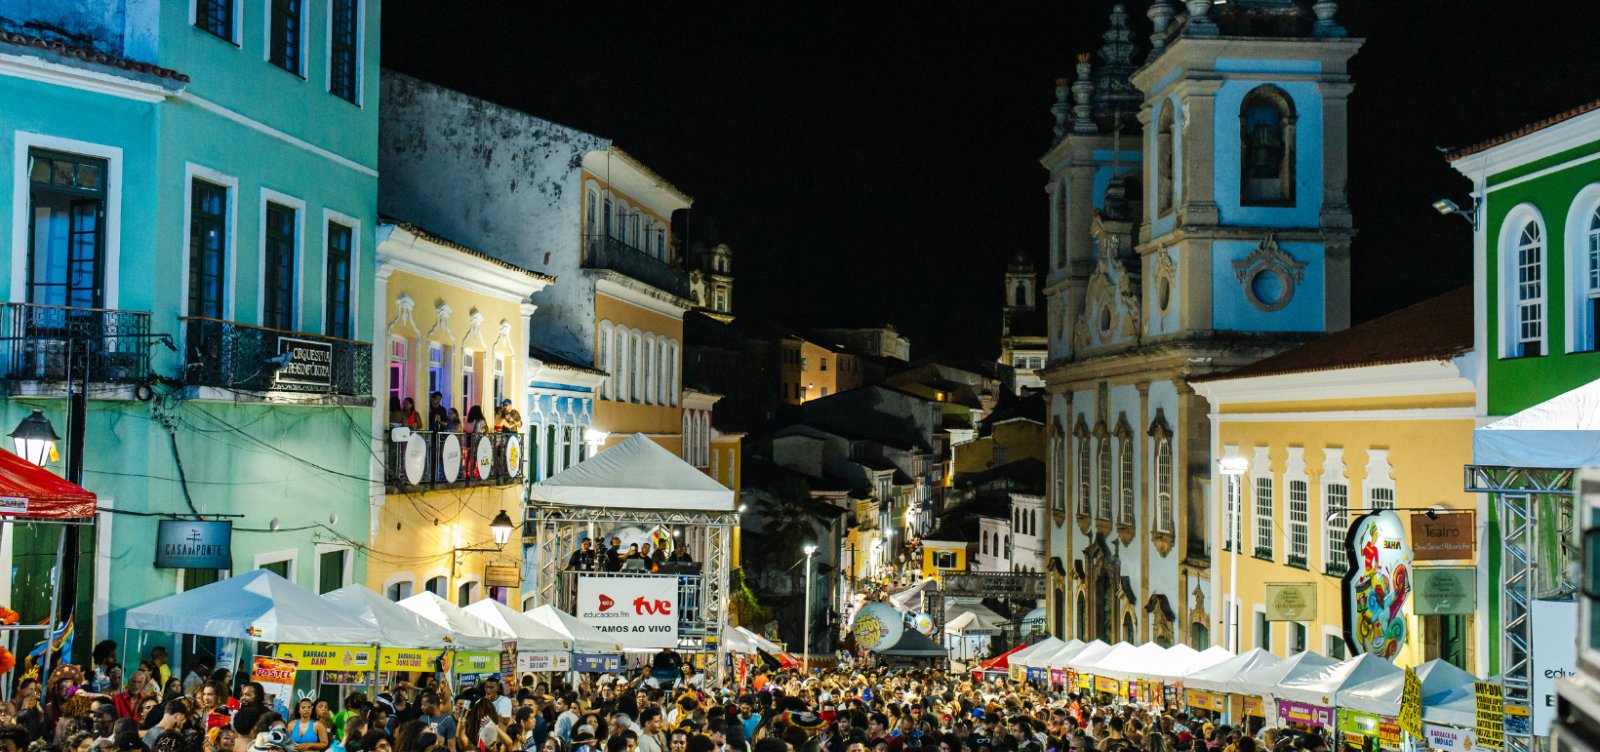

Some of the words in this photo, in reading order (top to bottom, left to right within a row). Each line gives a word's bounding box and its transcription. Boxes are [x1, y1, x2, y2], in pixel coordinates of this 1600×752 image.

[293, 348, 330, 362] ORQUESTRA
[1424, 525, 1460, 538] Teatro
[165, 544, 187, 556] CASA
[197, 545, 222, 556] PONTE
[633, 596, 671, 616] tve
[593, 625, 629, 633] TAMOS
[303, 650, 327, 658] BARRACA
[311, 658, 326, 666] DANI
[1431, 730, 1450, 739] BARRACA
